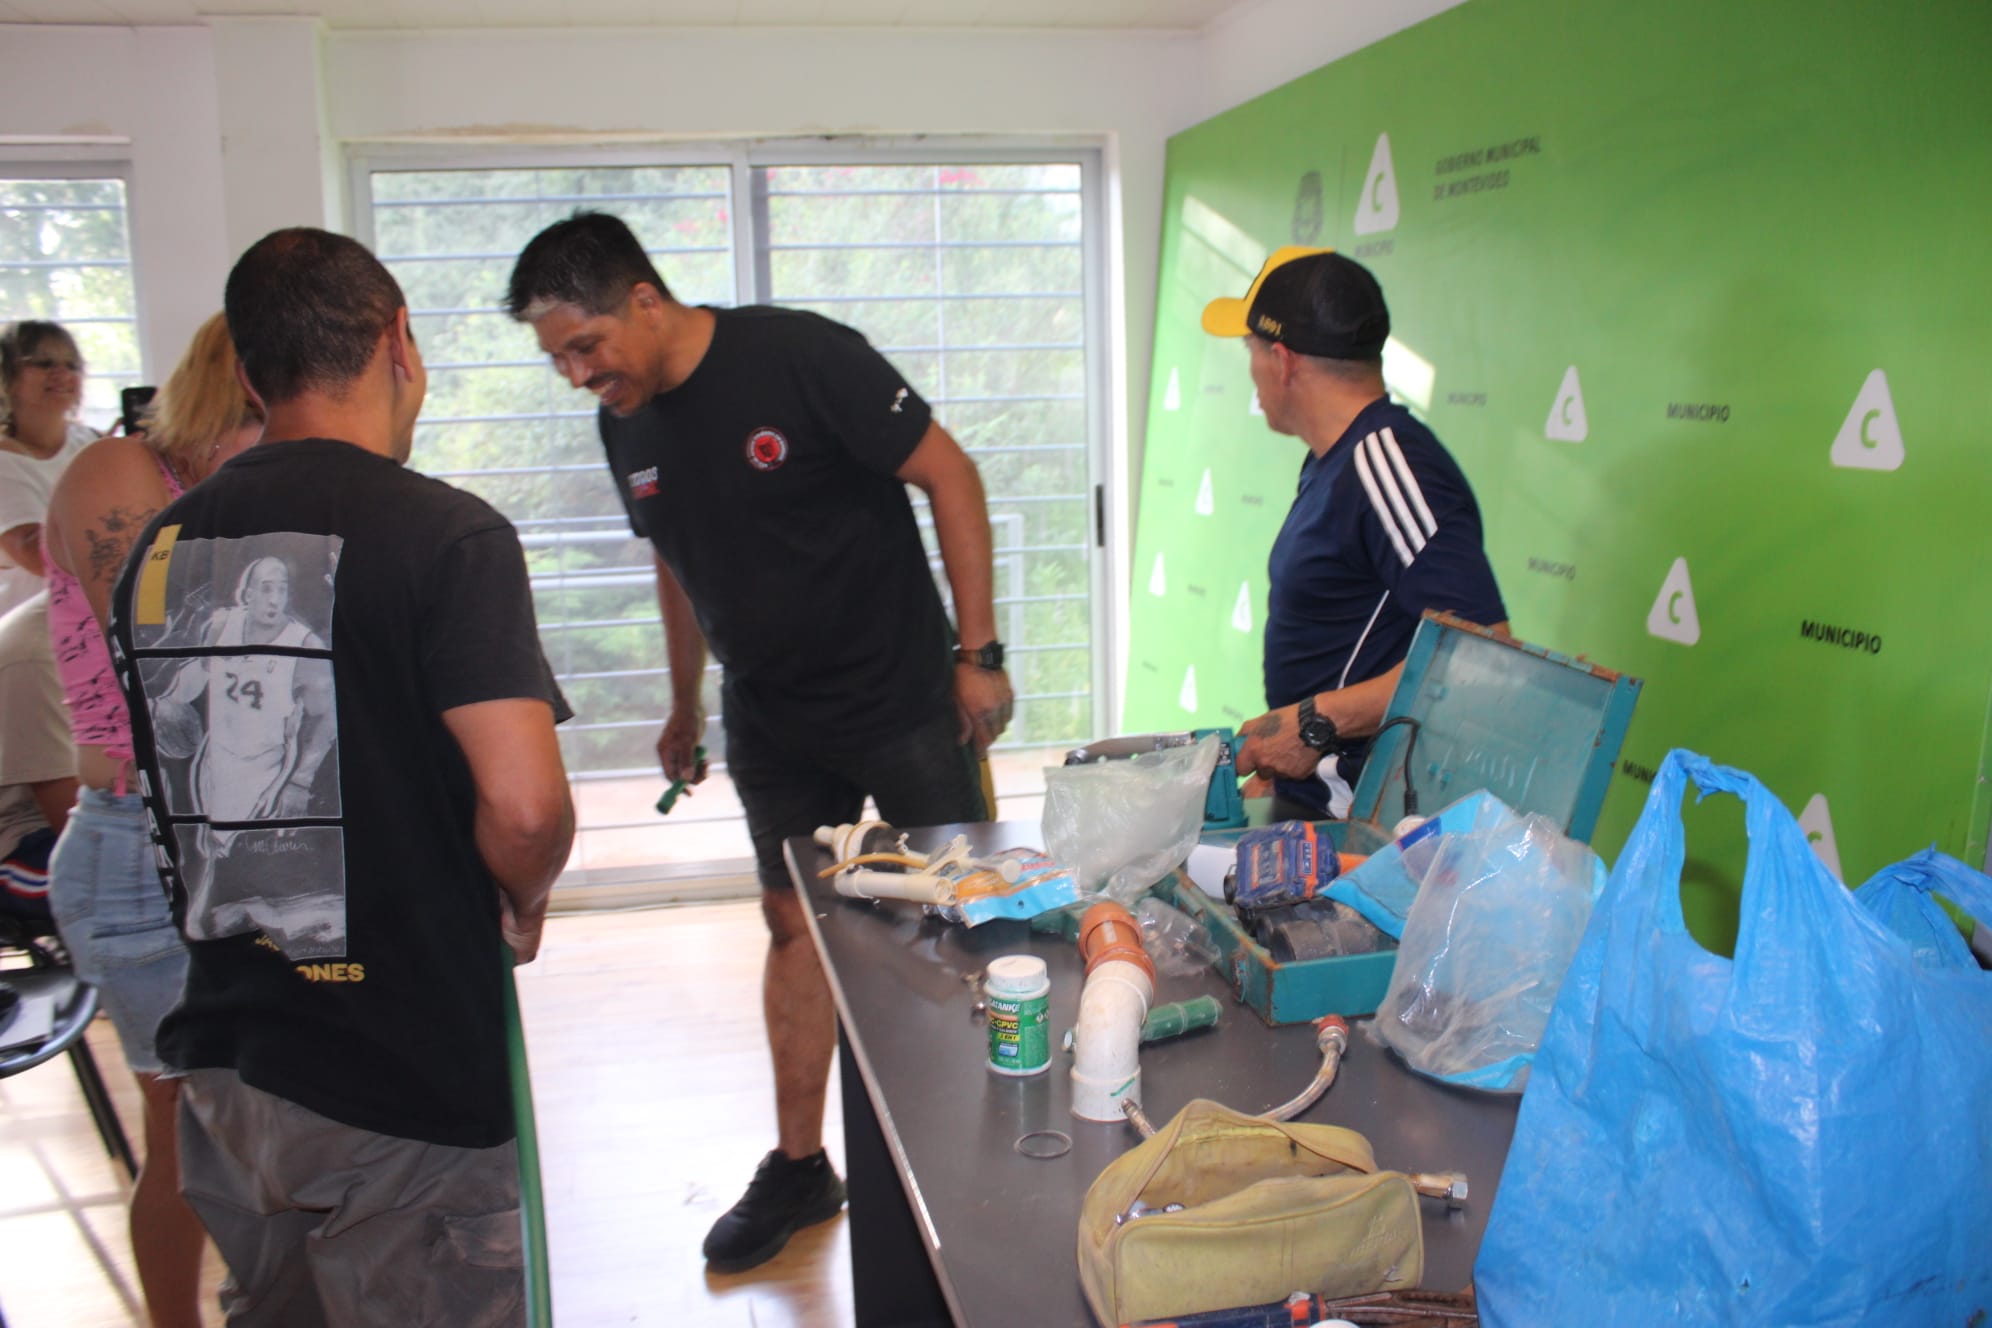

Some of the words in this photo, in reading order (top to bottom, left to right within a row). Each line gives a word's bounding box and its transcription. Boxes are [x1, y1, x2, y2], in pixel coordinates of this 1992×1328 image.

[1371, 171, 1385, 213] C
[1562, 396, 1574, 427] C
[1667, 403, 1730, 423] MUNICIPIO
[1860, 408, 1881, 449] C
[151, 551, 169, 561] KB
[1669, 590, 1683, 625] C
[1801, 619, 1882, 655] MUNICIPIO
[225, 671, 264, 710] 24
[1623, 759, 1658, 785] MUNI
